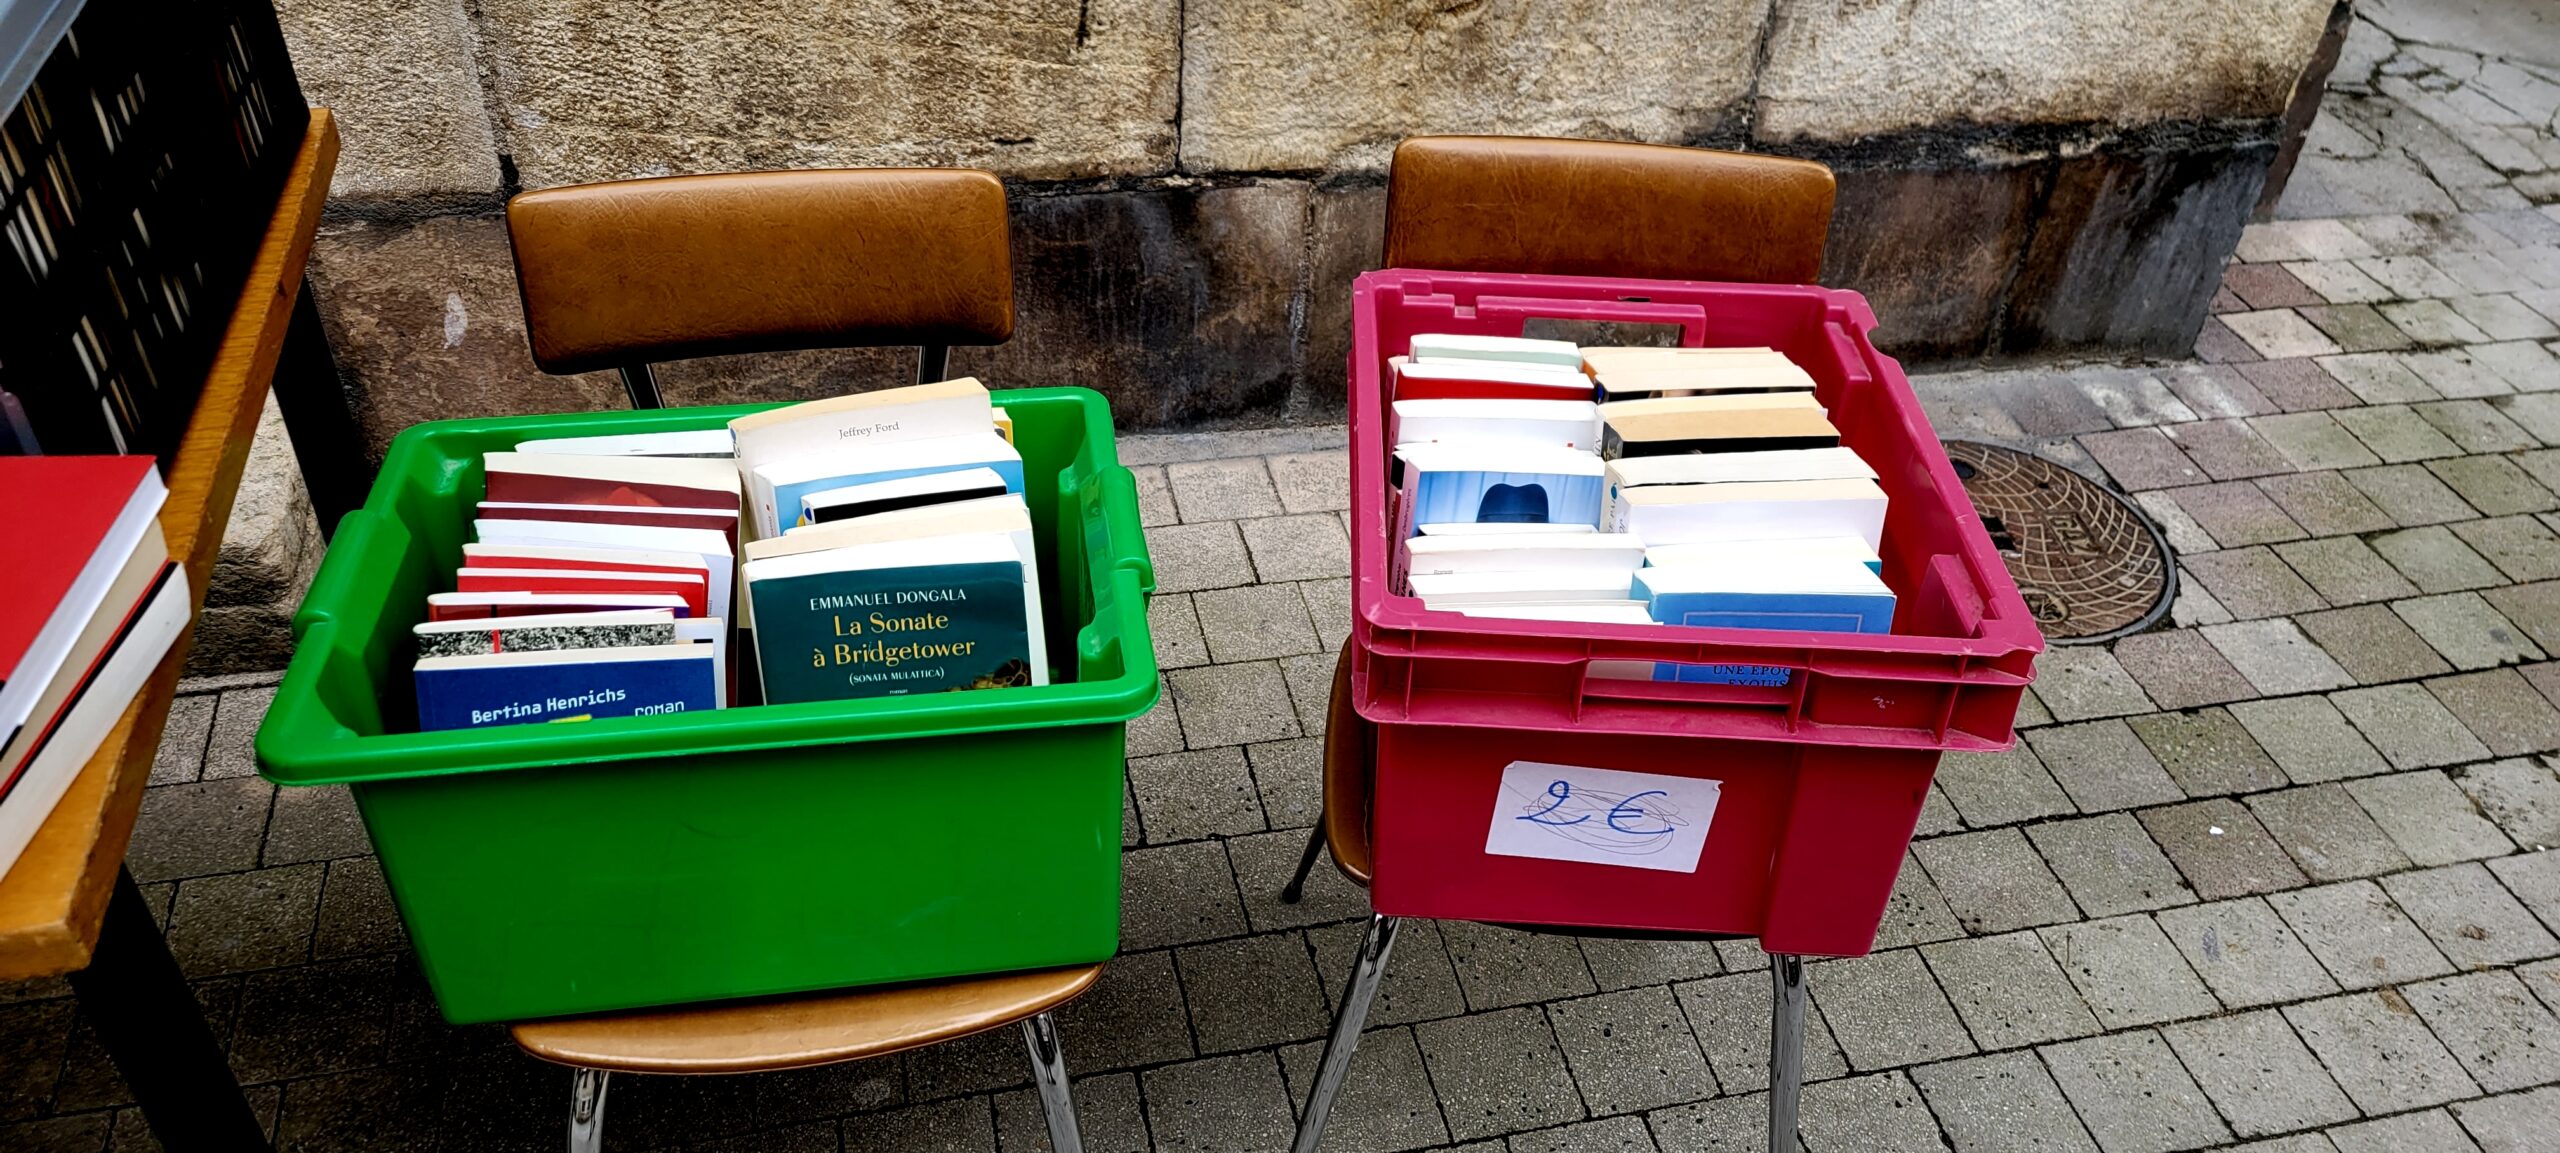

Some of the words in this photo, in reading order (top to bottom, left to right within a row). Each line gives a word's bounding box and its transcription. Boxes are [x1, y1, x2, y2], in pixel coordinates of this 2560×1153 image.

[839, 427, 872, 440] Jeffrey
[875, 421, 900, 433] Ford
[810, 592, 893, 611] EMMANUEL
[896, 588, 967, 604] DONGALA
[834, 615, 862, 636] La
[869, 612, 949, 633] Sonate
[813, 648, 826, 667] à
[834, 640, 976, 667] Bridgetower
[849, 672, 888, 686] (SONATA
[890, 666, 945, 680] MULATTICA)
[1713, 665, 1745, 675] UNE
[1751, 666, 1791, 676] EPOQ
[1728, 679, 1788, 687] EXQUIS
[471, 702, 542, 724] Bertina
[546, 688, 626, 712] Henrichs
[634, 701, 685, 716] roman
[1515, 780, 1591, 826] 2
[1607, 790, 1675, 835] €
